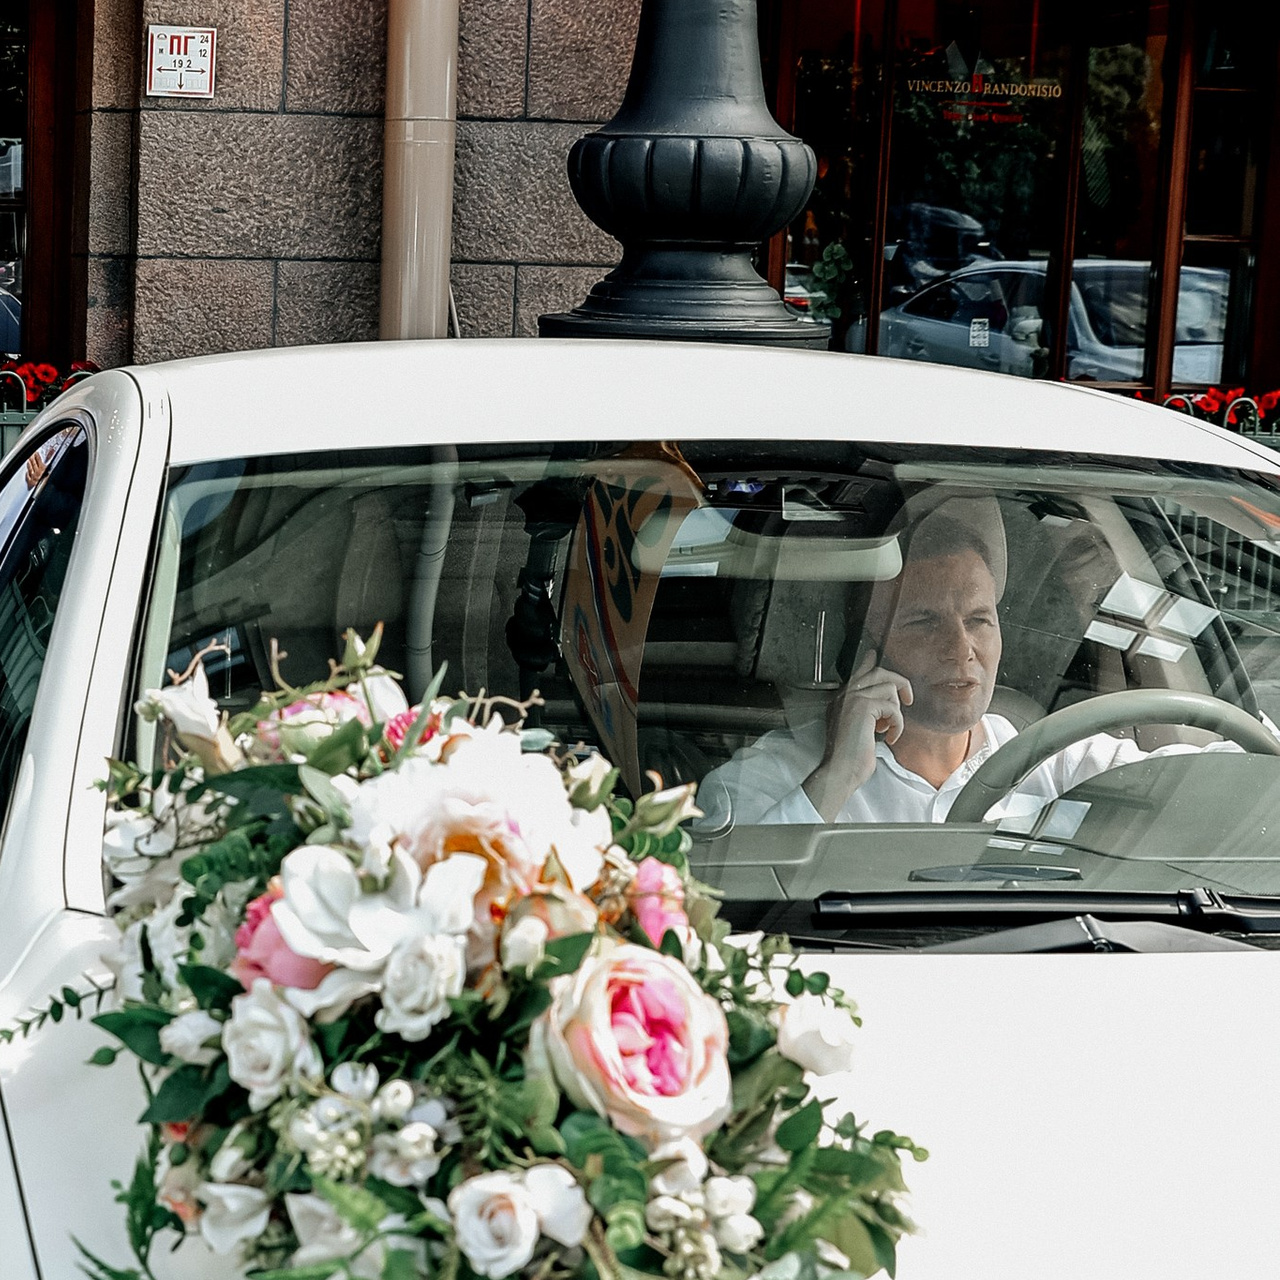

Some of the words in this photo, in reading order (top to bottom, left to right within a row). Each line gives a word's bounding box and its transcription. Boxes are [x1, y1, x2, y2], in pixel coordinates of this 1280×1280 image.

[169, 34, 196, 55] ПГ
[200, 34, 209, 44] 24
[199, 48, 208, 58] 12
[907, 79, 970, 94] VINCENZO
